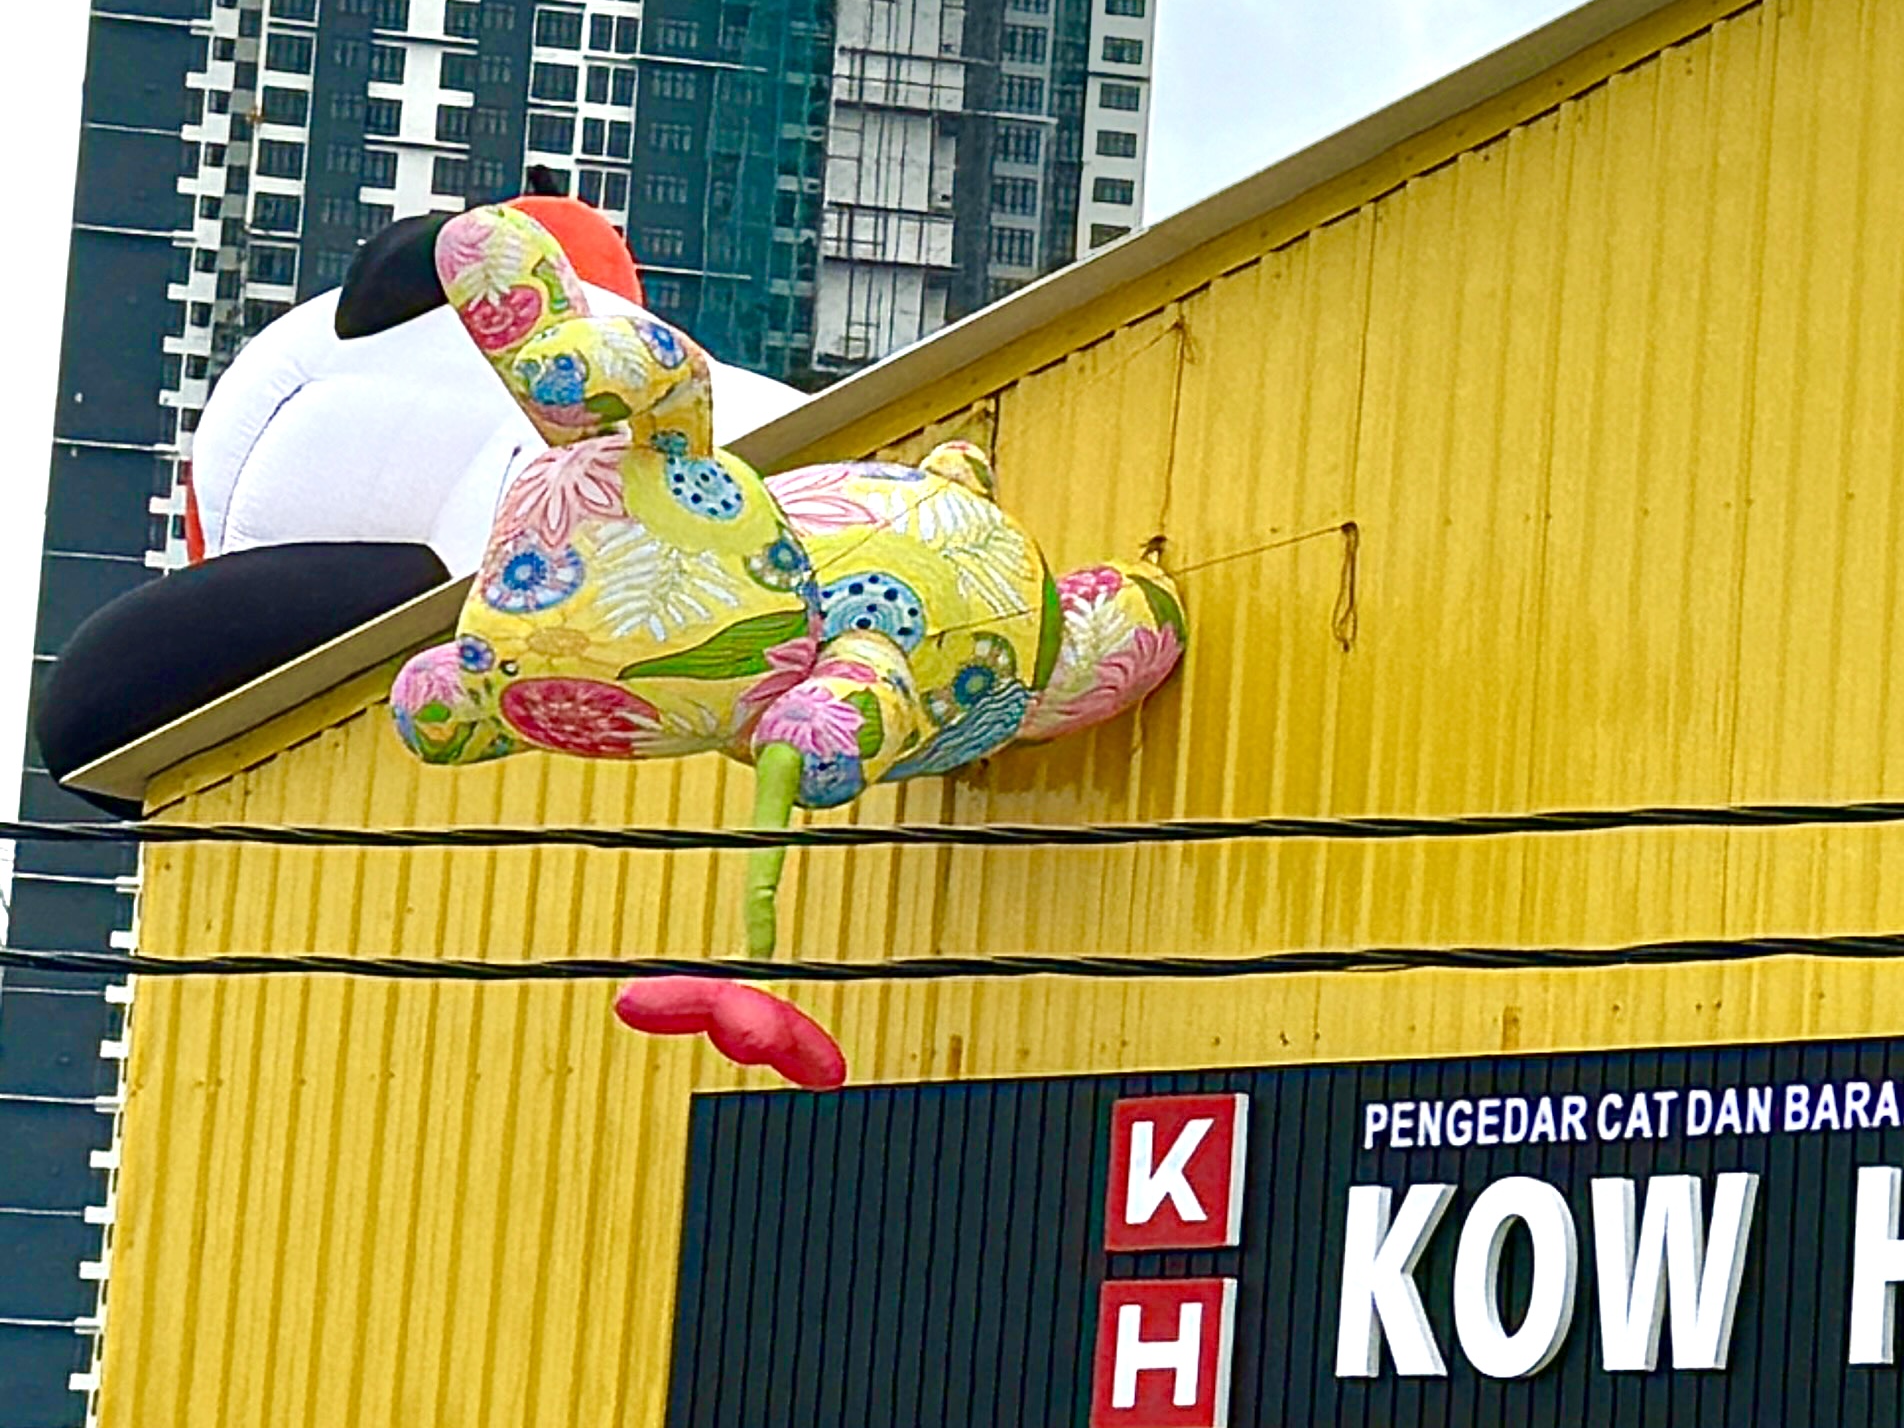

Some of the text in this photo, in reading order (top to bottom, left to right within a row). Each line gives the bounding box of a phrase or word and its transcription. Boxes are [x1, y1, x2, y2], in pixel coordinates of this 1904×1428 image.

[1123, 1117, 1214, 1227] K
[1363, 1095, 1588, 1151] PENGEDAR
[1596, 1090, 1680, 1141] CAT
[1685, 1086, 1774, 1137] DAN
[1336, 1172, 1760, 1378] KOW
[1110, 1302, 1204, 1410] H
